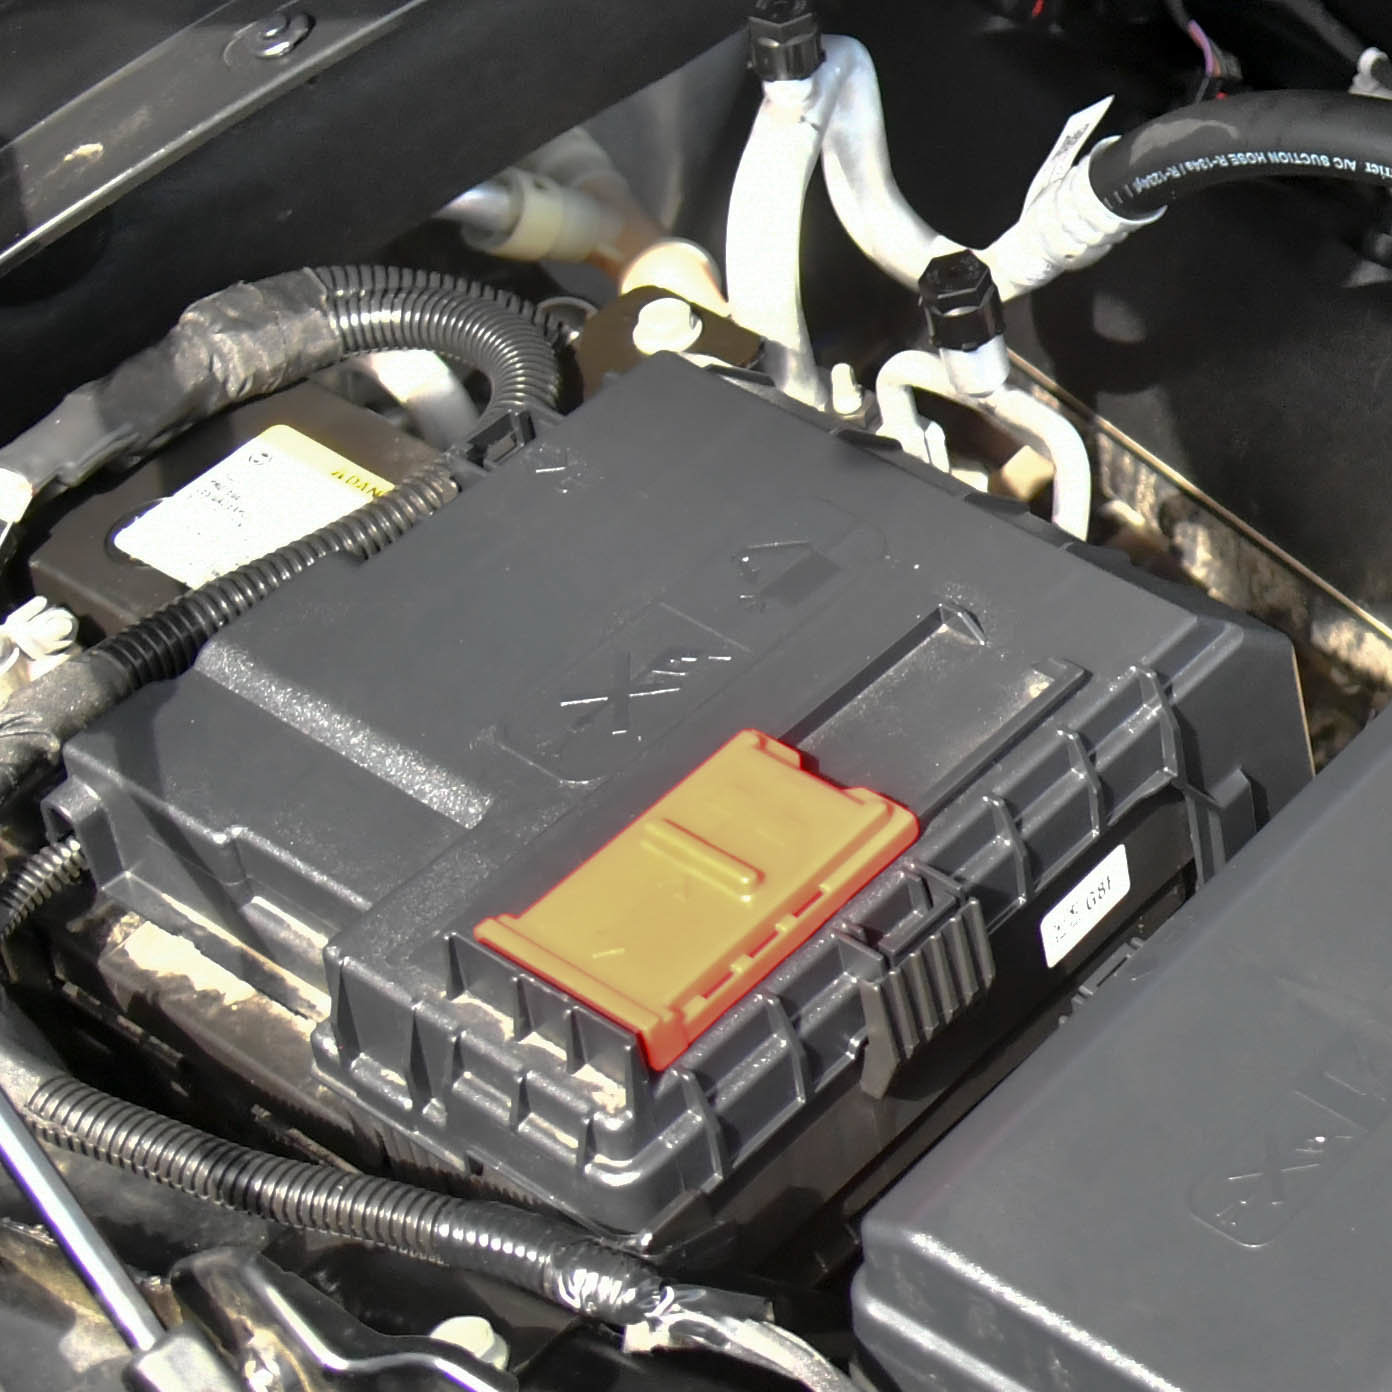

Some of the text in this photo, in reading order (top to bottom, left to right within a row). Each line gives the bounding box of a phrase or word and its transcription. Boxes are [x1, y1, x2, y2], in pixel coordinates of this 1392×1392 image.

[1187, 154, 1229, 171] R-134a
[1228, 151, 1267, 166] HOSE
[1268, 150, 1330, 168] SUCTION
[1332, 156, 1357, 172] A/C
